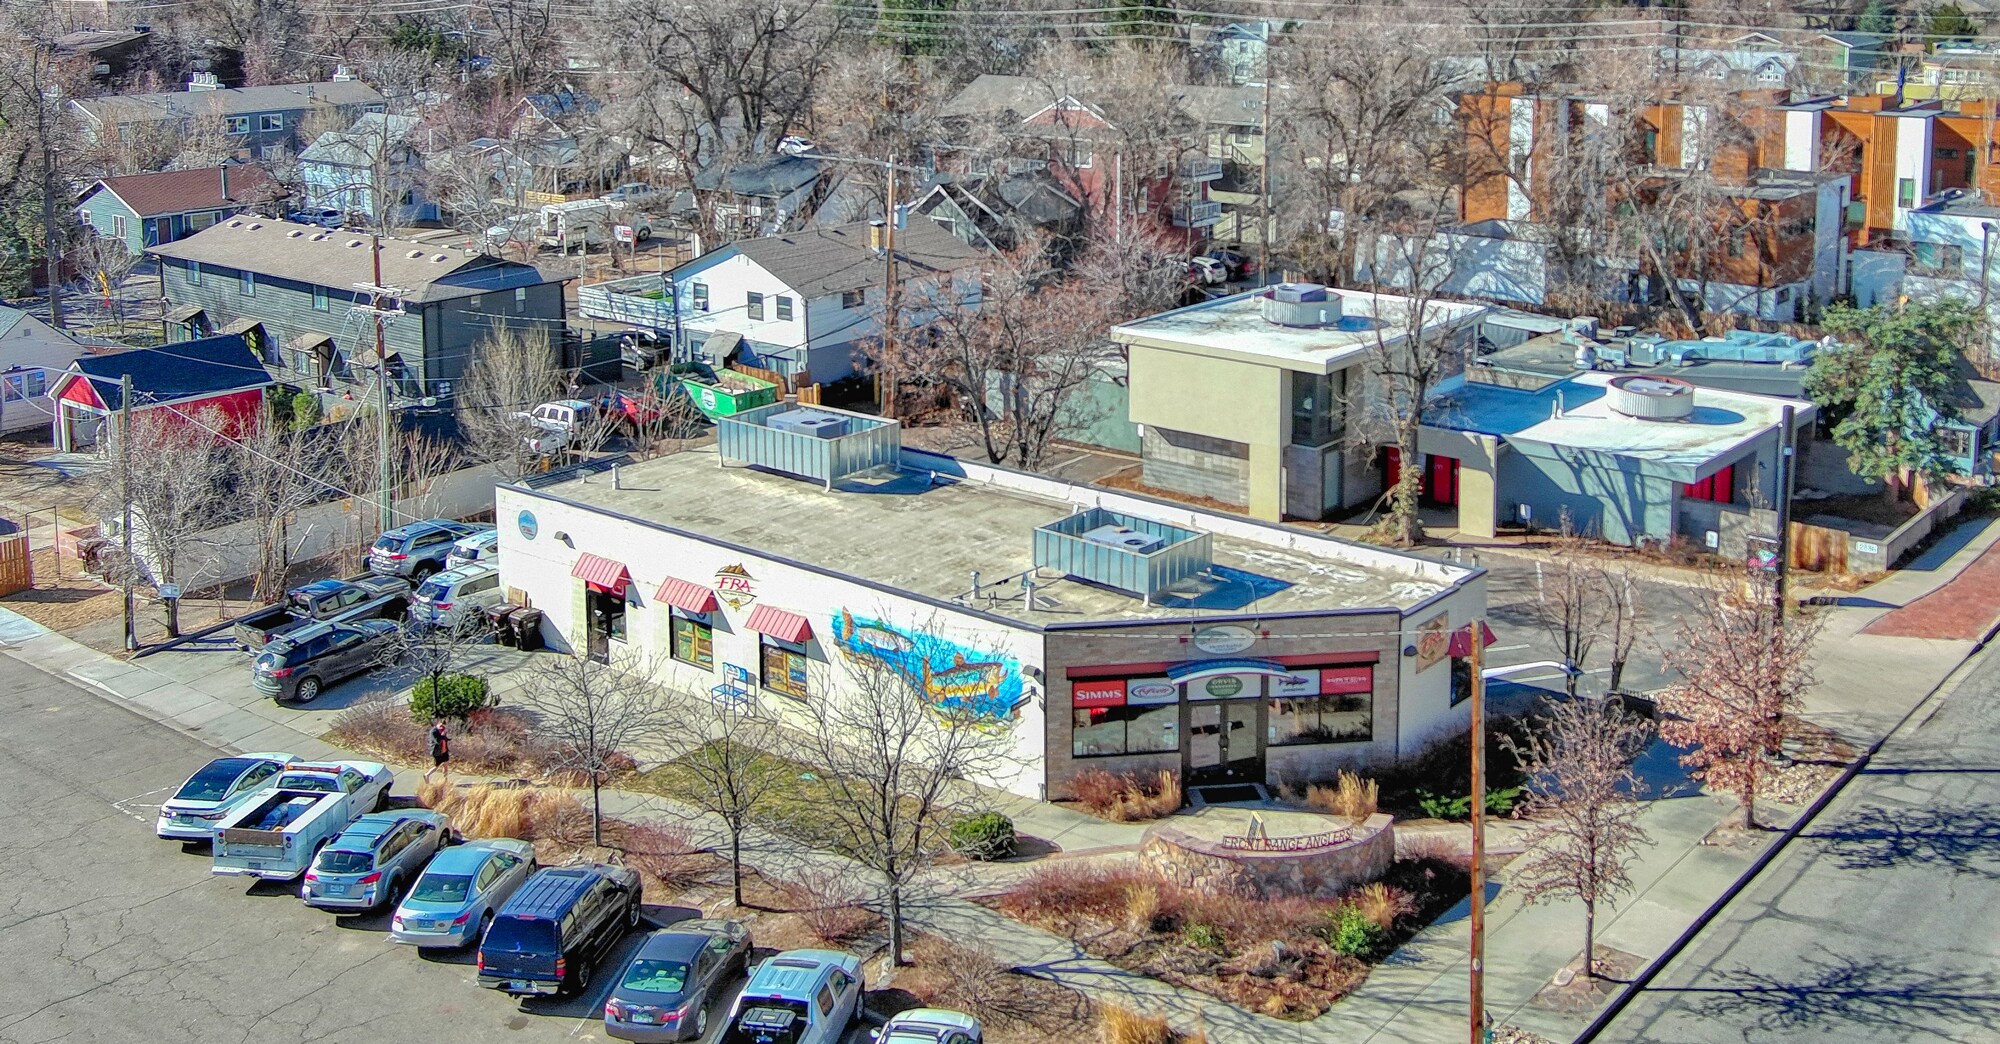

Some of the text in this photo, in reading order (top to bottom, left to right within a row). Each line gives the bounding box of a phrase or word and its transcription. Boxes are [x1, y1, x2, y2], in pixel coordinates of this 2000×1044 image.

[719, 577, 751, 592] FRA
[1076, 689, 1122, 701] SIMMS
[1264, 836, 1304, 851] RANGE
[1306, 827, 1352, 849] ANGLERS
